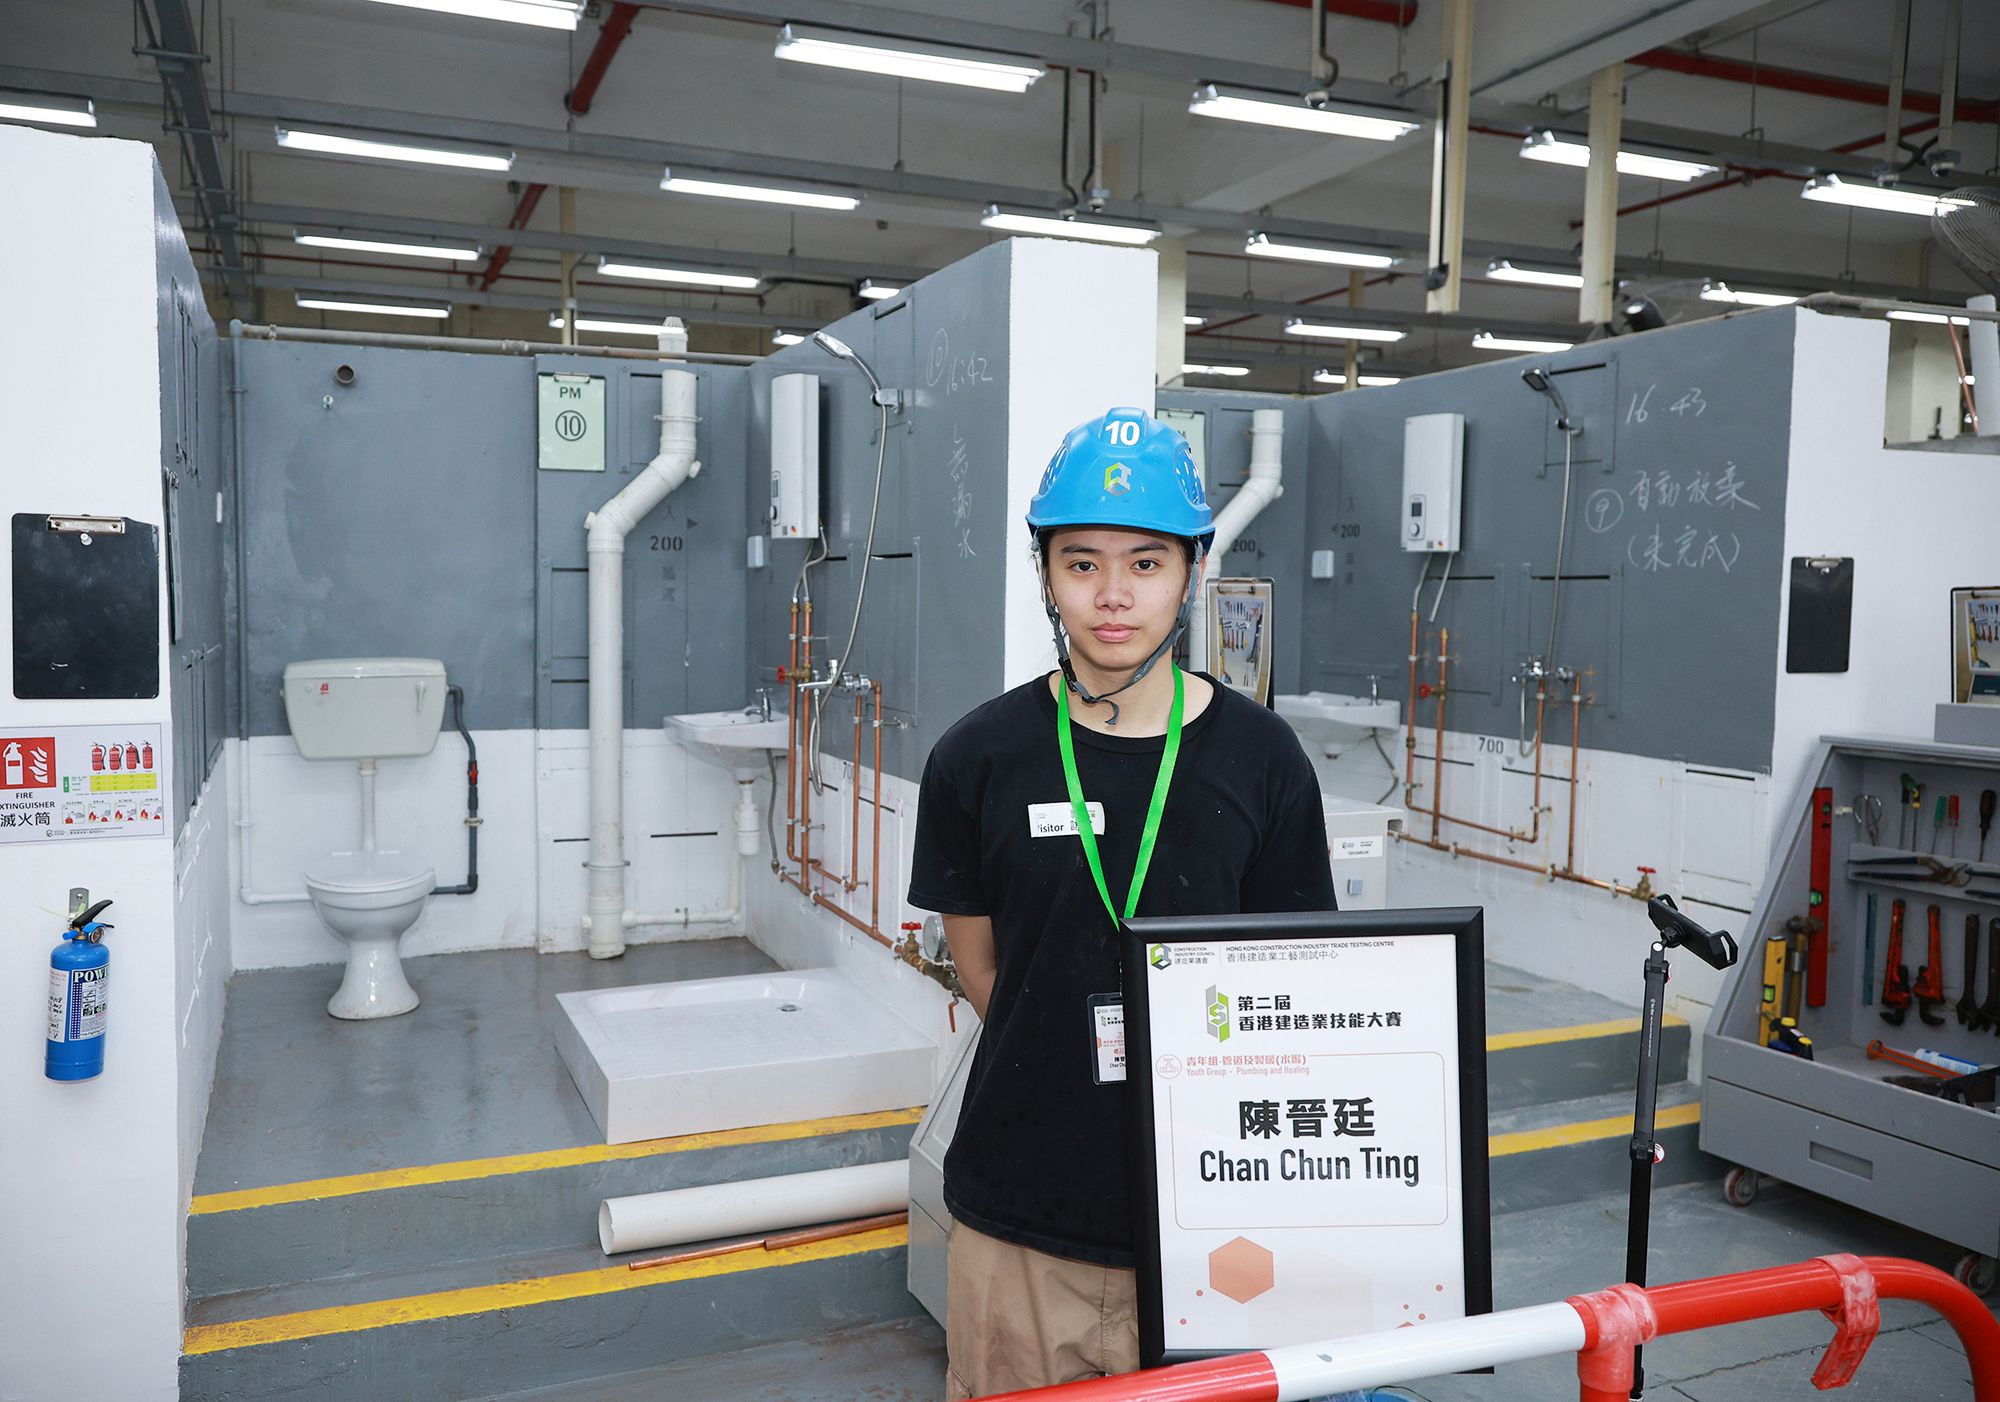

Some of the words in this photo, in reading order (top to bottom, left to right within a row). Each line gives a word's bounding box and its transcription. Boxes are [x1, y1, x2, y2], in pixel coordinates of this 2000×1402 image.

[947, 352, 993, 395] 16:42
[559, 386, 582, 399] PM
[1105, 420, 1140, 446] 10
[1340, 523, 1361, 539] 200
[649, 535, 683, 551] 200
[1232, 539, 1256, 552] 200
[1479, 736, 1504, 754] 700
[15, 791, 33, 799] FIRE
[0, 811, 51, 828] 滅火筒
[1238, 995, 1291, 1012] 第二屆
[1239, 1011, 1402, 1032] 香港建造業技能大賽
[1187, 1068, 1205, 1076] Youth
[1207, 1068, 1227, 1077] Group
[1236, 1066, 1269, 1076] Plumbing
[1284, 1065, 1310, 1075] Heating
[1238, 1096, 1376, 1140] 陳晉廷
[1199, 1149, 1270, 1182] Chan
[1280, 1148, 1351, 1181] Chun
[1359, 1147, 1420, 1188] Ting
